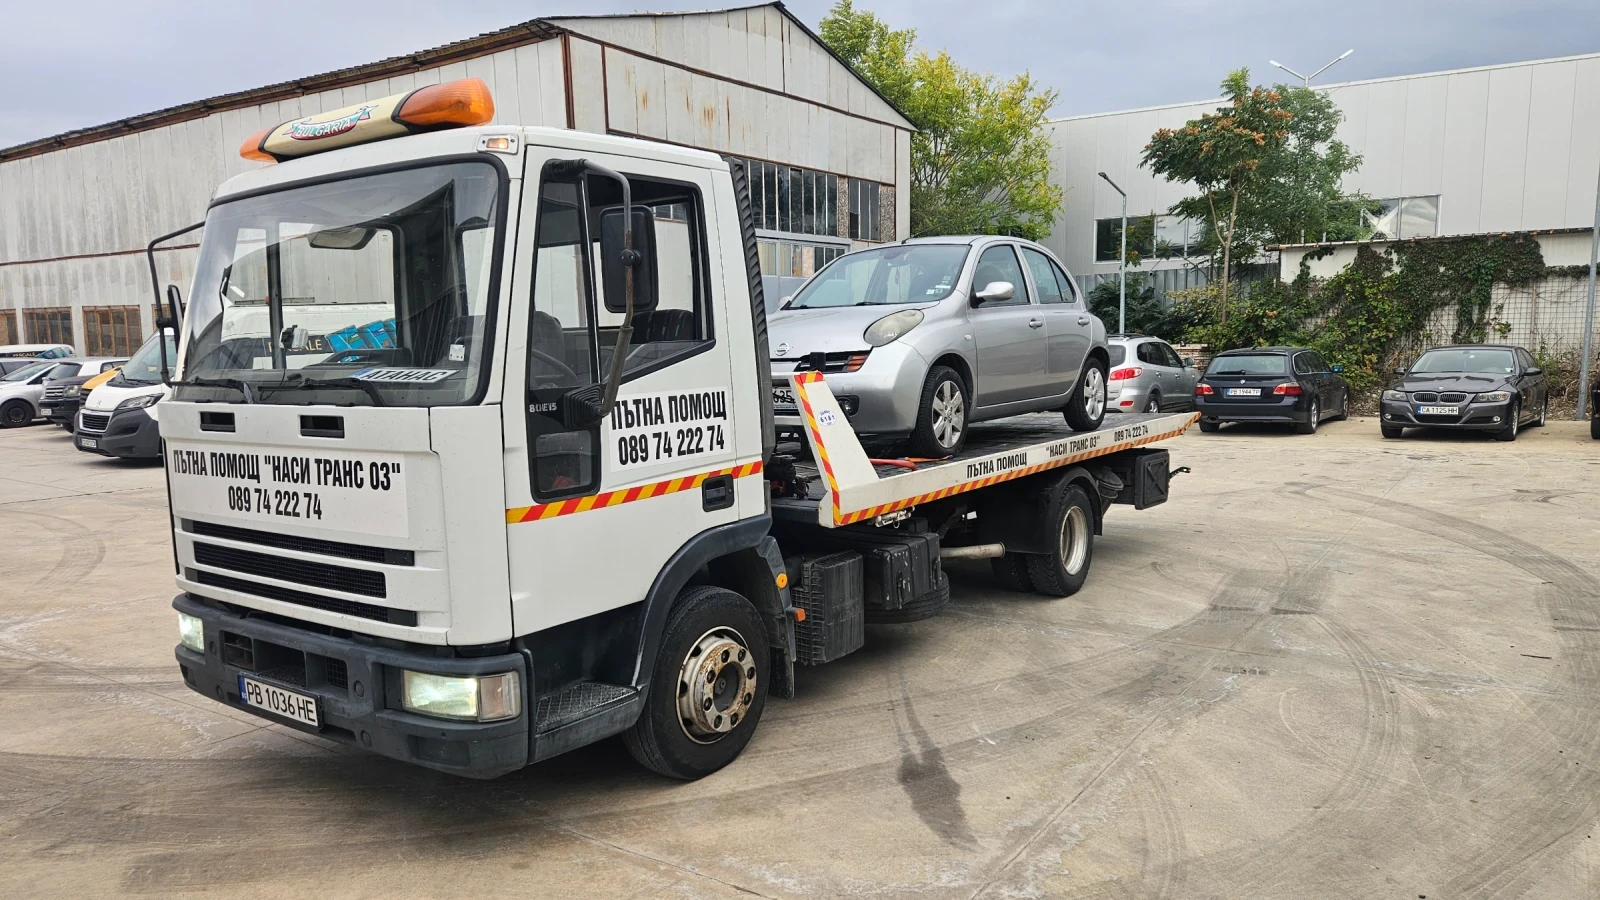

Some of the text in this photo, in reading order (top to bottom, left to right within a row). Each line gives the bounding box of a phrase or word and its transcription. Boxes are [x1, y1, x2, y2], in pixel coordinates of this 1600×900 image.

[295, 118, 352, 137] BULGARIA
[362, 370, 448, 380] АТАНАС
[611, 391, 727, 430] ПЪТНА ПОМОЩ
[618, 424, 725, 466] 089 74 222 74
[1114, 424, 1149, 443] 089 74 222 74
[173, 450, 208, 476] ПЪТНА
[210, 452, 261, 483] ПОМОЩ
[264, 455, 311, 484] "НАСИ
[314, 458, 364, 489] ТРАНС
[966, 462, 995, 479] ПЪТНА
[996, 452, 1028, 471] ПОМОЩ
[1045, 441, 1068, 458] "НАСИ
[1069, 438, 1089, 454] ТРАНС
[228, 485, 323, 520] 089 74 222 74
[246, 681, 316, 722] PB 1036 HE
